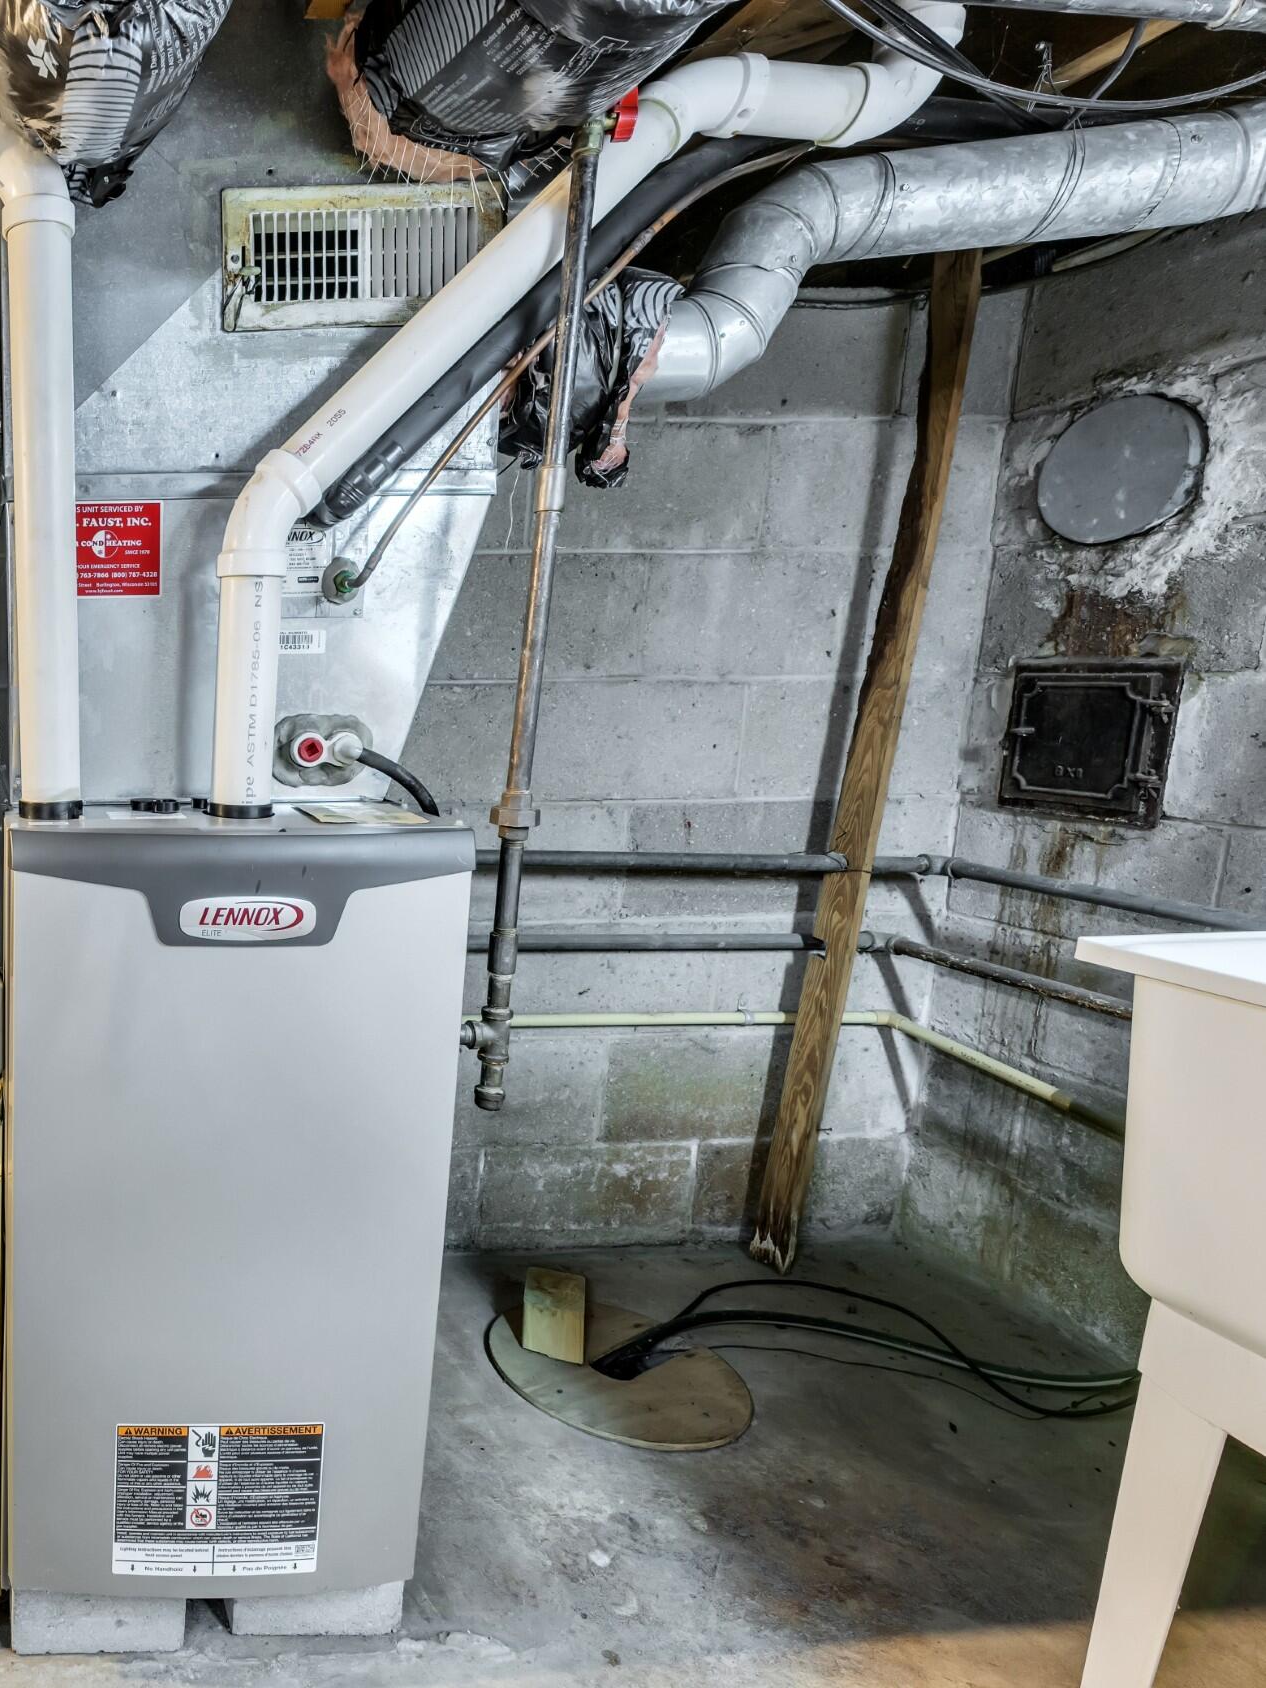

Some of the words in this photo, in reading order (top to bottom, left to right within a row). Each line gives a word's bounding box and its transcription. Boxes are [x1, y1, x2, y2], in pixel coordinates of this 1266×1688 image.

[100, 505, 133, 513] SERVICED
[82, 517, 124, 528] FAUST,
[126, 516, 152, 527] INC.
[106, 539, 142, 547] HEATING
[254, 575, 264, 608] NS
[250, 620, 261, 707] D1785-06
[247, 713, 257, 768] ASTM
[242, 776, 256, 804] ipe
[198, 907, 285, 926] LENNOX
[201, 929, 223, 937] ELITE
[134, 1427, 183, 1435] WARNING
[234, 1426, 318, 1435] AVERTISSEMENT
